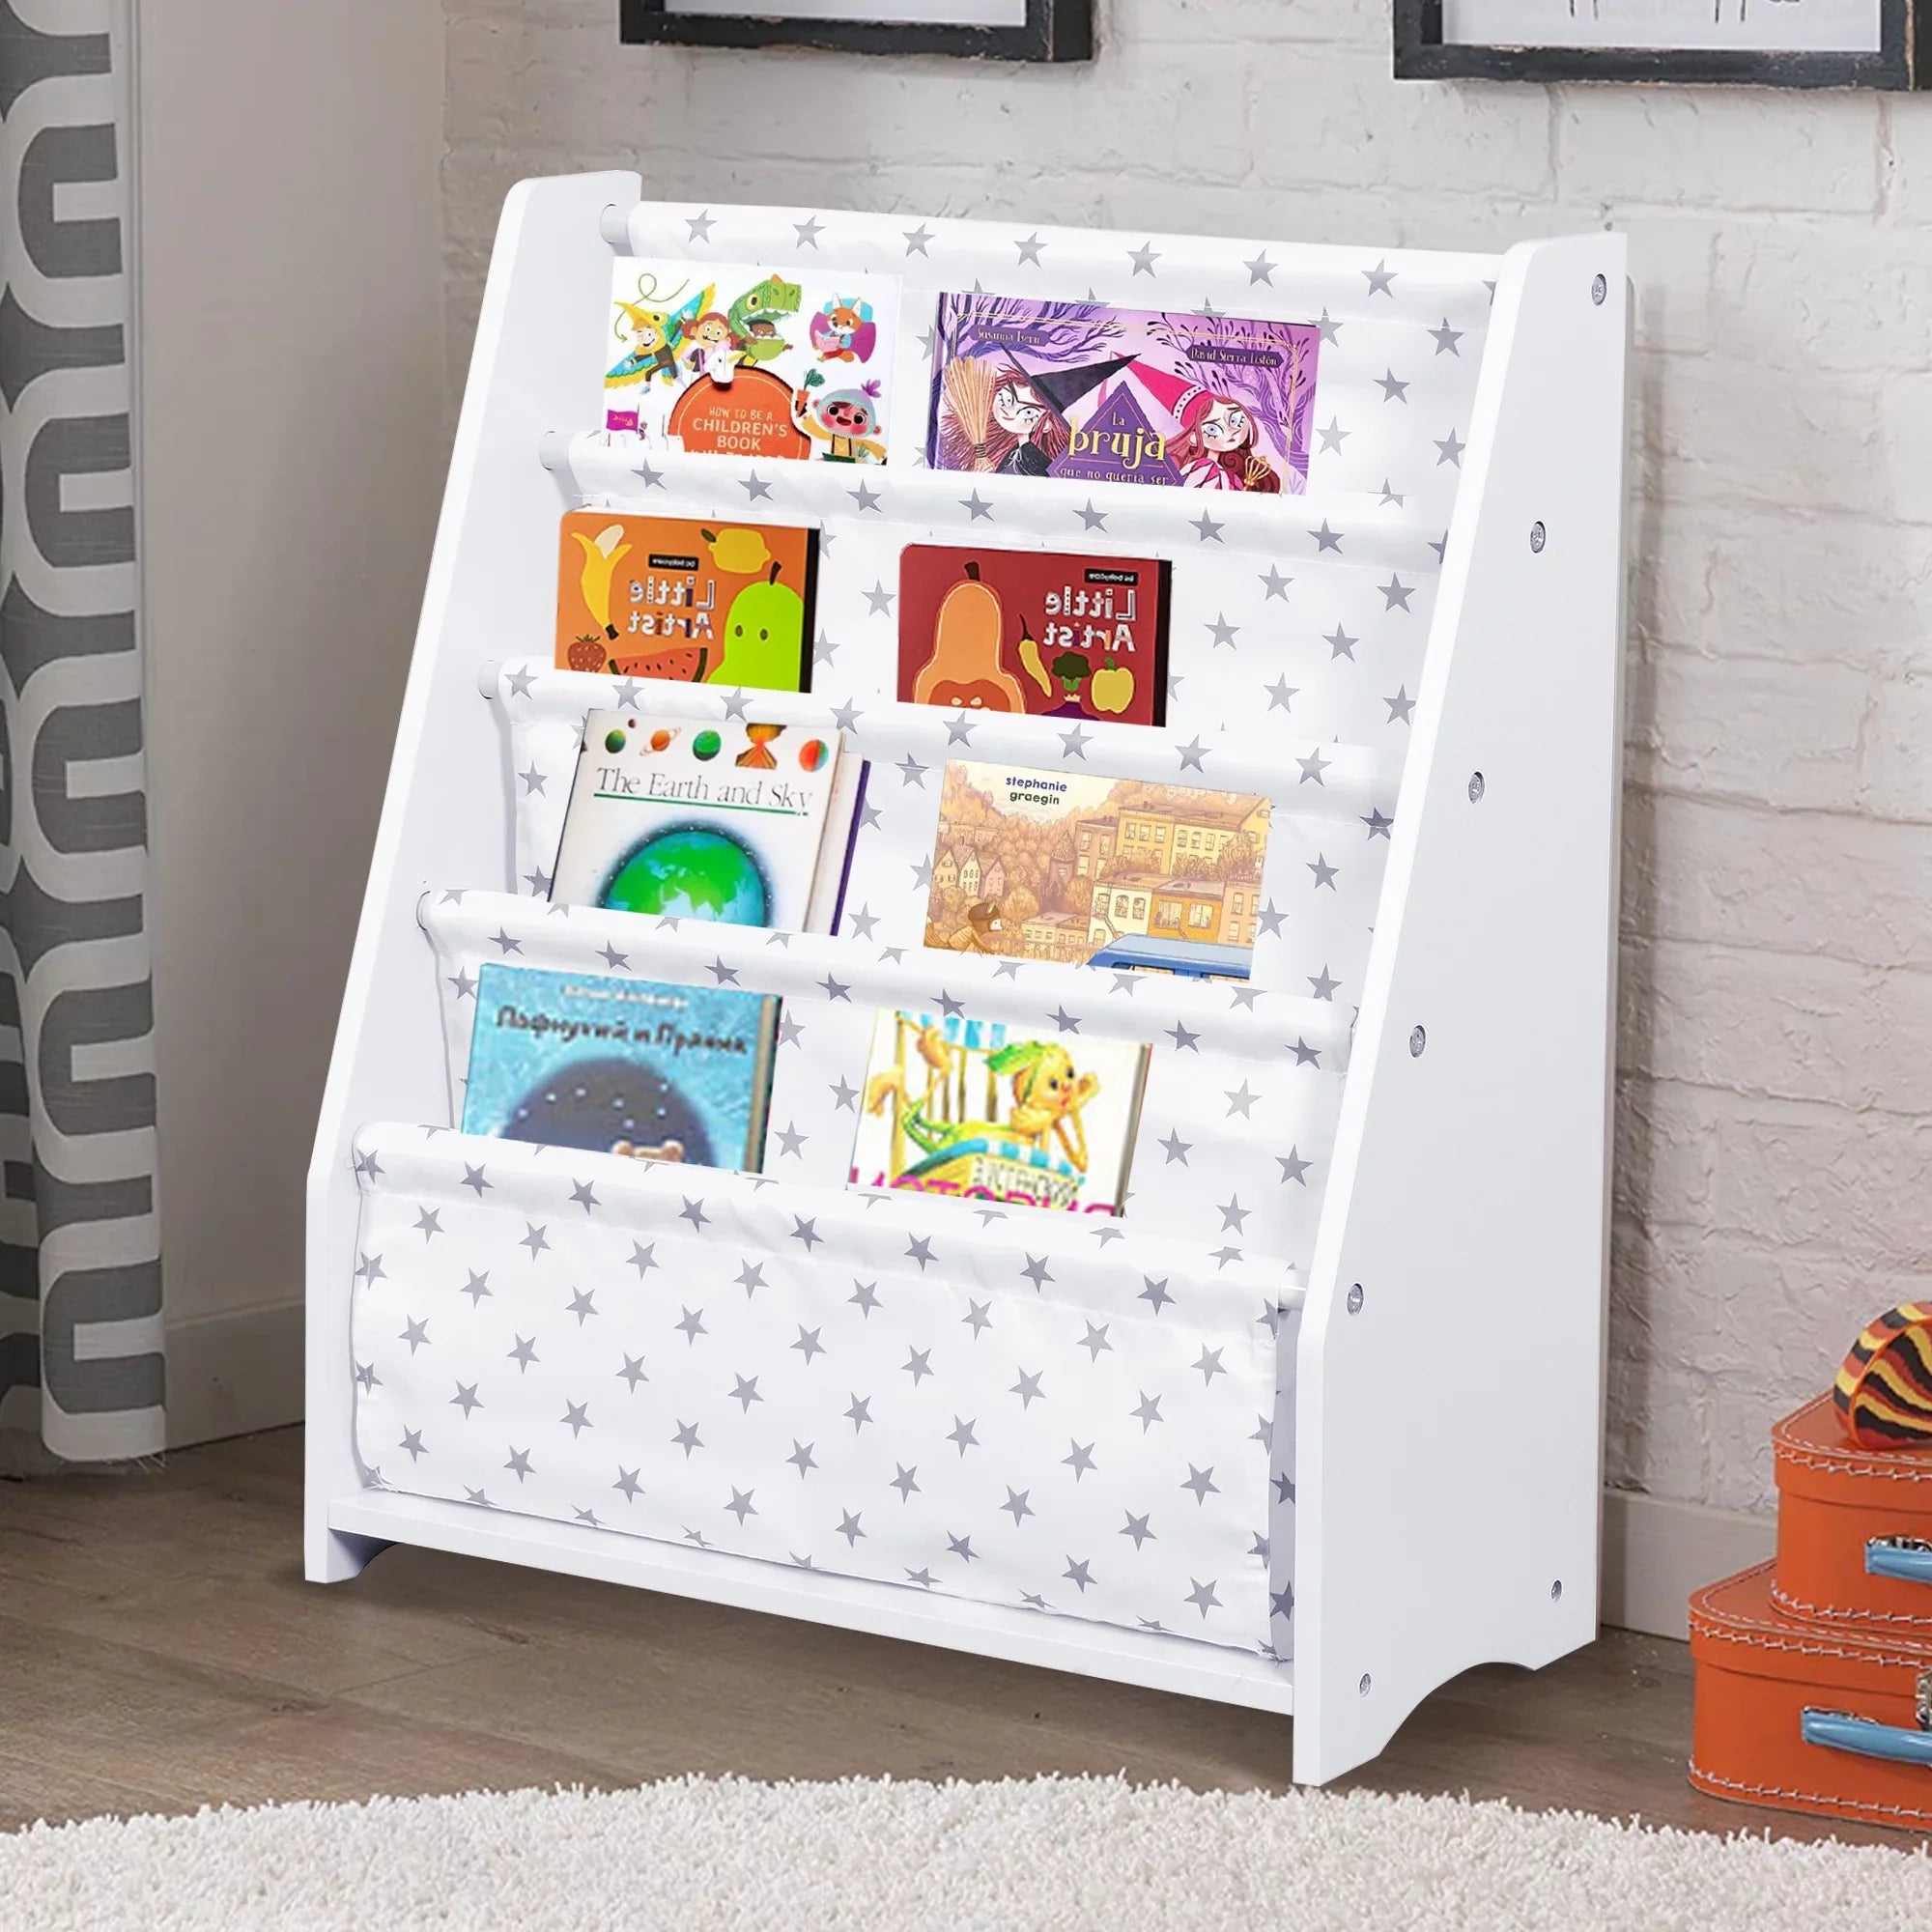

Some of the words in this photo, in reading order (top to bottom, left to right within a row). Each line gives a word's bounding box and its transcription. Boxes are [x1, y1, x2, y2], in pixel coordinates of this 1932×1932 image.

[1191, 347, 1216, 360] David
[1219, 350, 1246, 362] Sierra
[709, 407, 730, 418] HOW
[735, 409, 746, 418] TO
[750, 410, 763, 420] BE
[766, 411, 774, 420] A
[1112, 412, 1125, 426] La
[692, 417, 788, 438] CHILDREN'S
[717, 436, 761, 450] BOOK
[1068, 416, 1166, 469] bruja
[1060, 468, 1081, 478] que
[1087, 469, 1101, 479] no
[597, 767, 640, 794] The
[648, 772, 708, 800] Earth
[717, 781, 762, 805] and
[768, 782, 812, 808] Sky
[1006, 777, 1067, 792] stephanie
[1009, 792, 1060, 806] graegin
